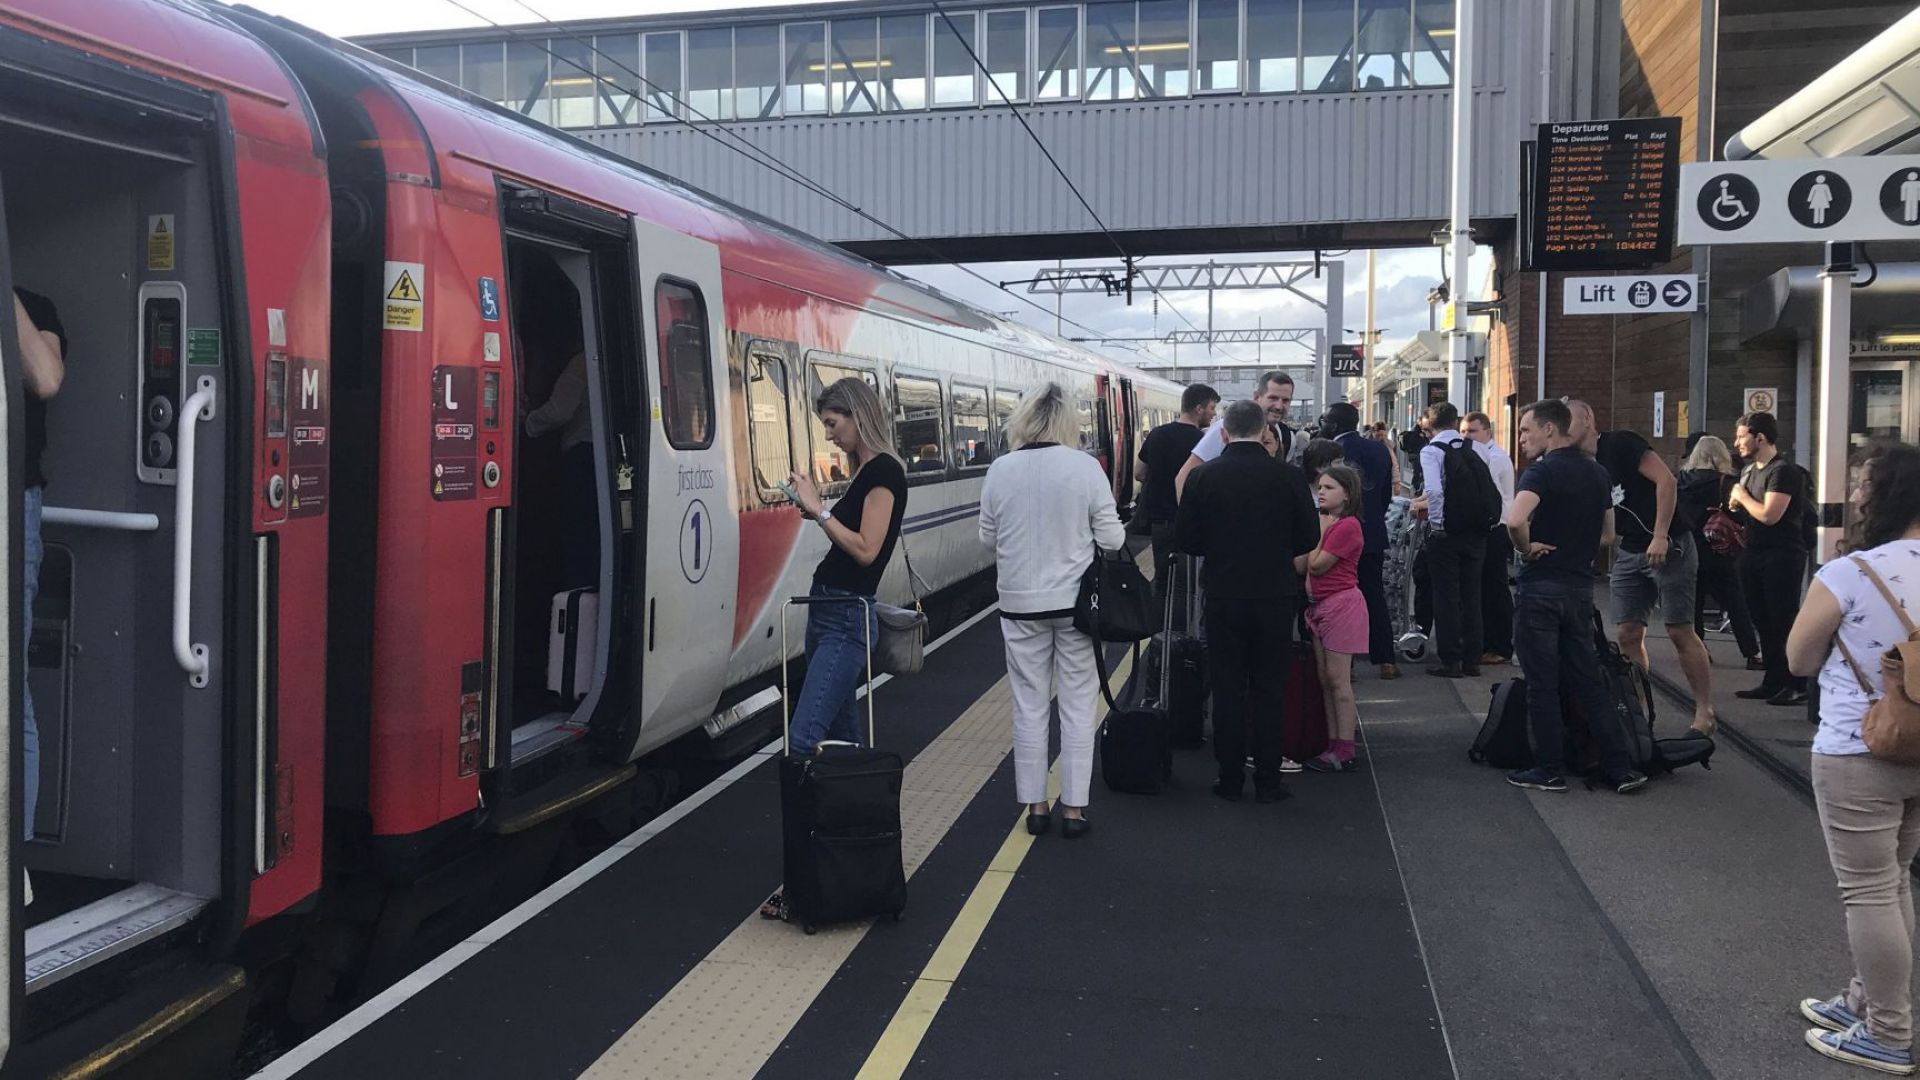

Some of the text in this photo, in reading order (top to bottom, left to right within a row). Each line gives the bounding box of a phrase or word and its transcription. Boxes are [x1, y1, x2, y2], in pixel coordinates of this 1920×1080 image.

[1552, 124, 1609, 134] Departures
[1545, 244, 1566, 252] Page
[1580, 285, 1615, 302] Lift
[387, 305, 416, 314] Danger
[1861, 344, 1877, 352] Lift
[1880, 344, 1890, 352] to
[1334, 360, 1360, 371] J/K
[1416, 366, 1429, 374] Way
[302, 368, 319, 410] M
[445, 374, 458, 410] L
[1656, 407, 1661, 433] 3
[676, 464, 714, 496] first class
[691, 511, 700, 570] 1
